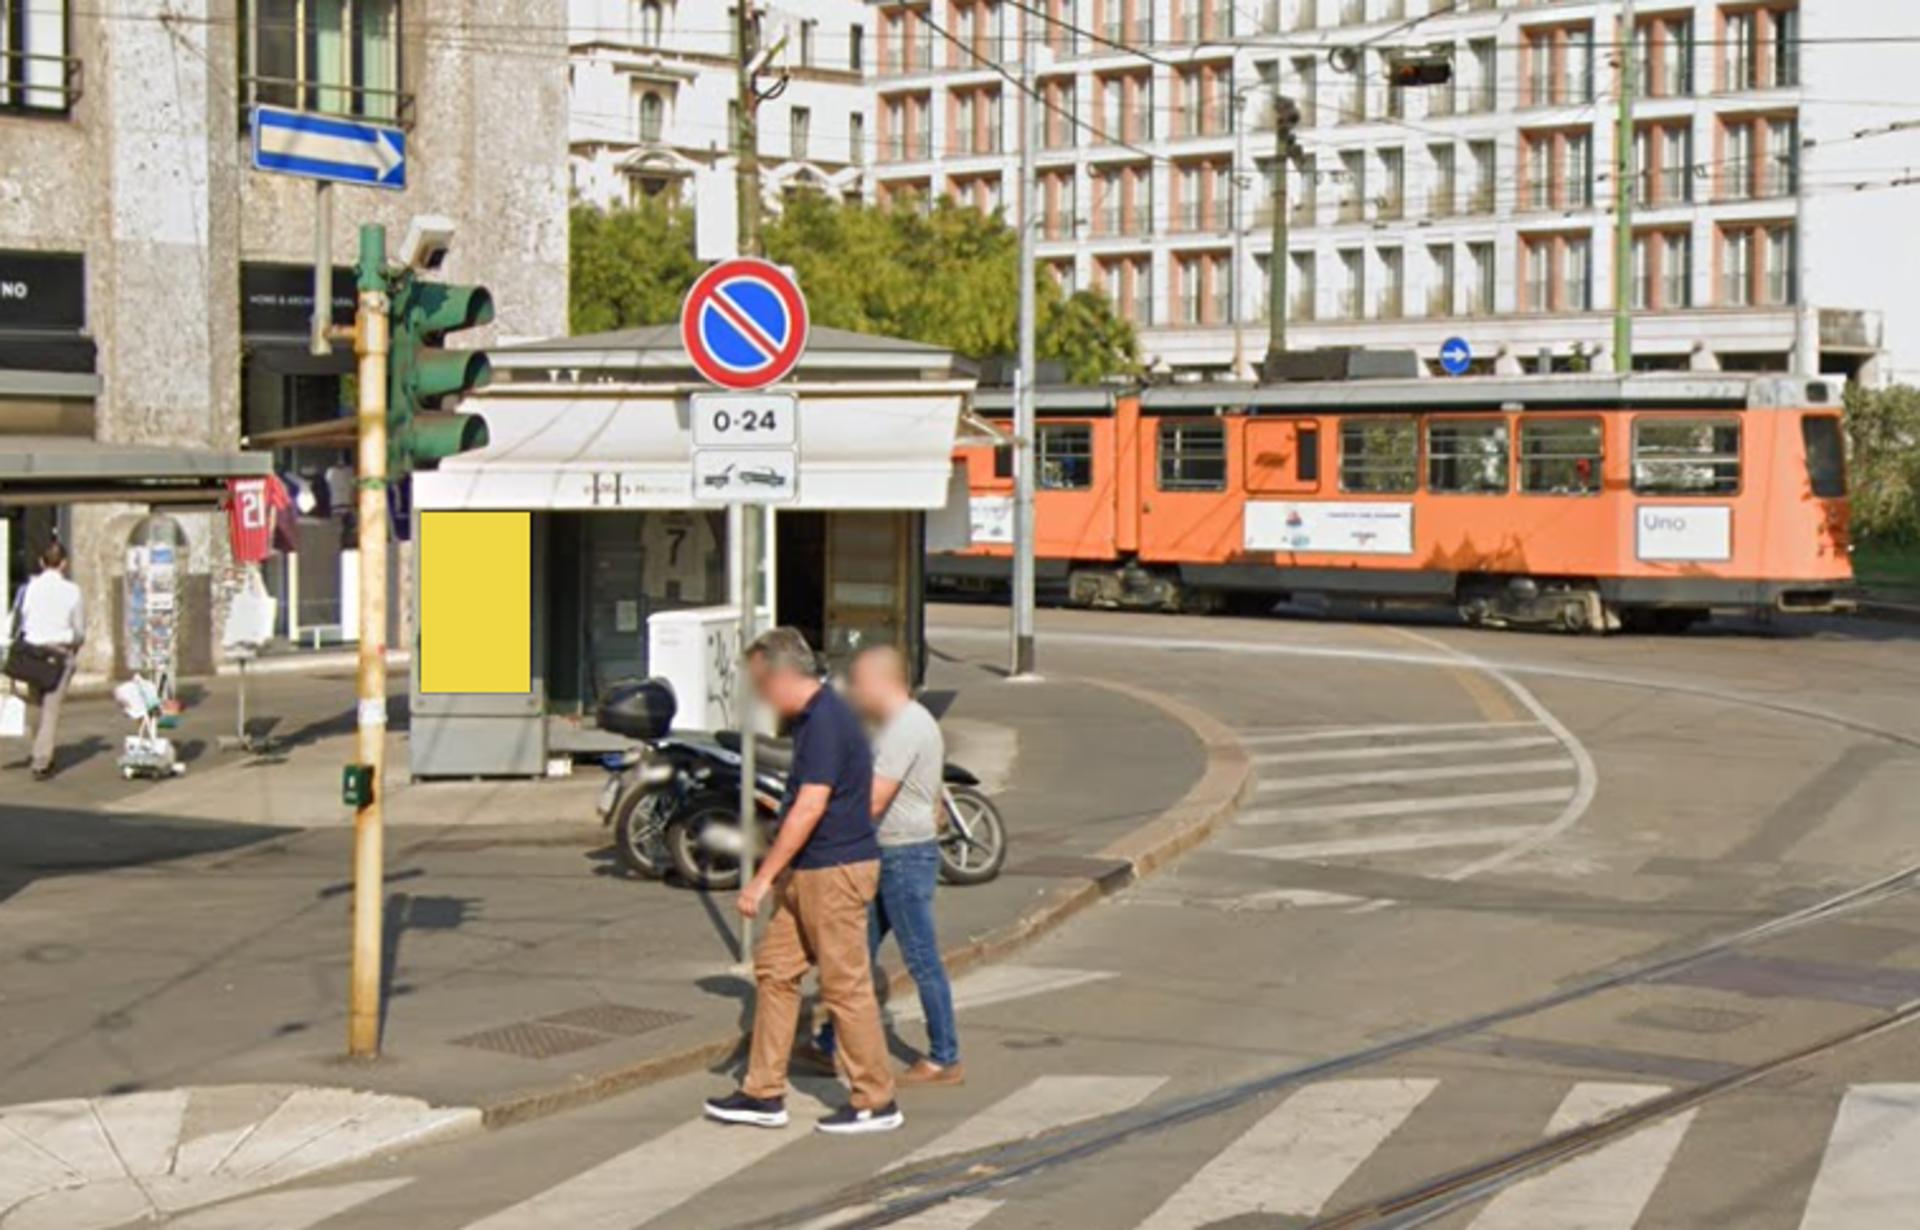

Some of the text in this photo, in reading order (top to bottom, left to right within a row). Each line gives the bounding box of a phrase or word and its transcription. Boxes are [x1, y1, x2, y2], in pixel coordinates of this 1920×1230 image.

[713, 409, 776, 433] 0-24
[242, 491, 267, 529] 21
[1643, 514, 1686, 531] Uno
[666, 529, 686, 567] 7
